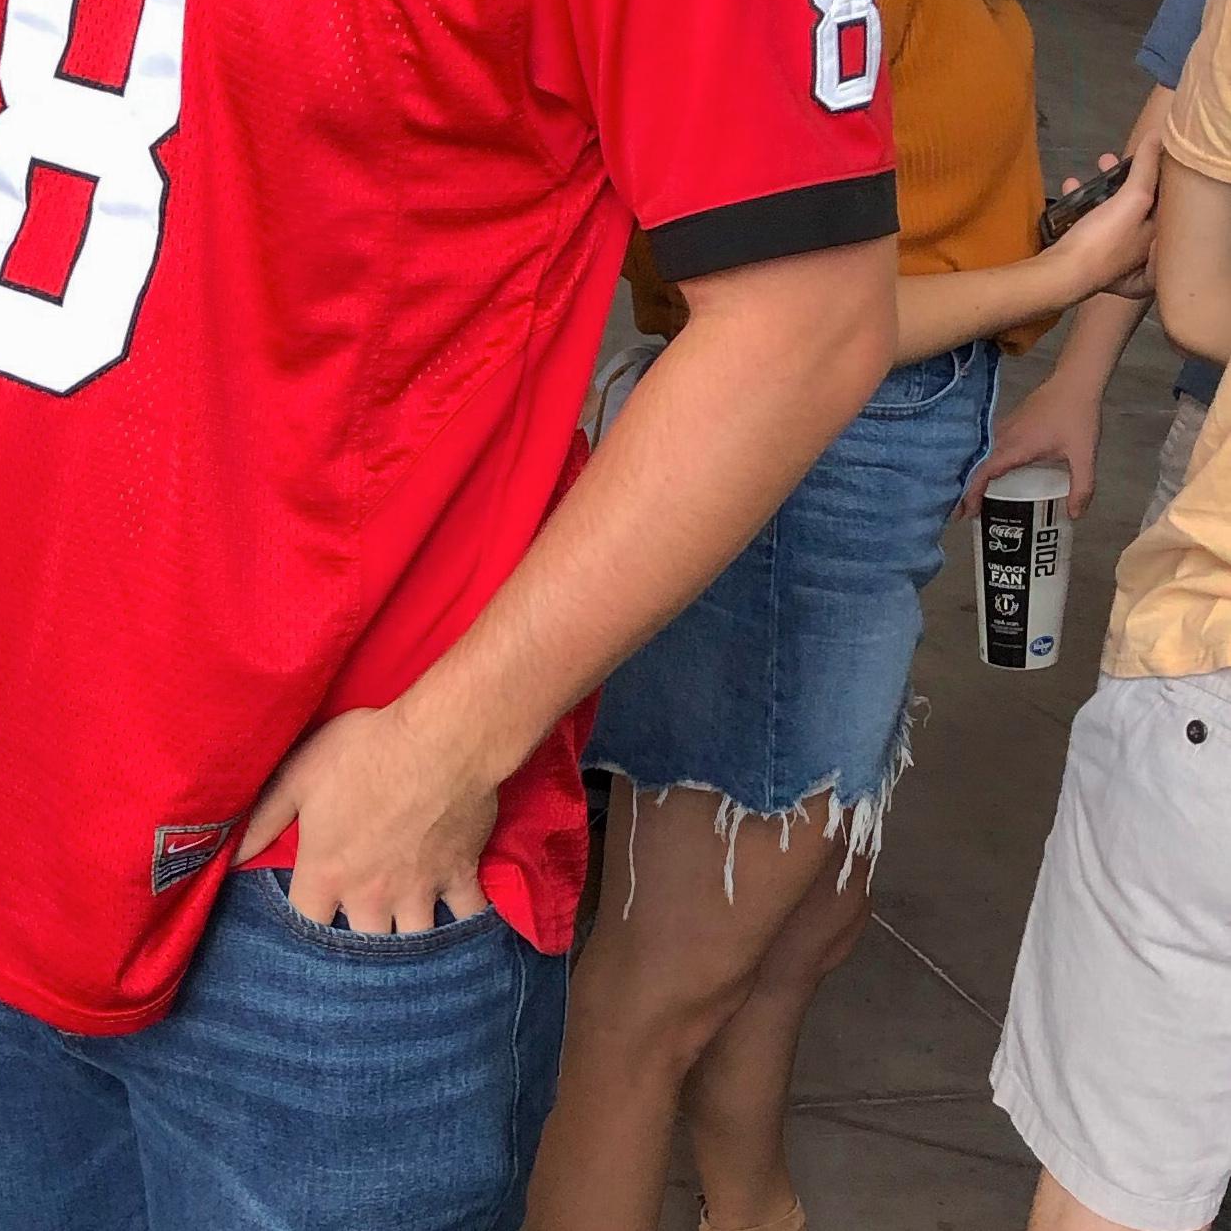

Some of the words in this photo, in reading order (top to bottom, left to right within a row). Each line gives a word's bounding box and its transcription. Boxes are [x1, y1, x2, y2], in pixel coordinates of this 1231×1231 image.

[1035, 529, 1058, 578] 2019
[988, 562, 1026, 574] UNLOCK
[991, 571, 1022, 585] FAN
